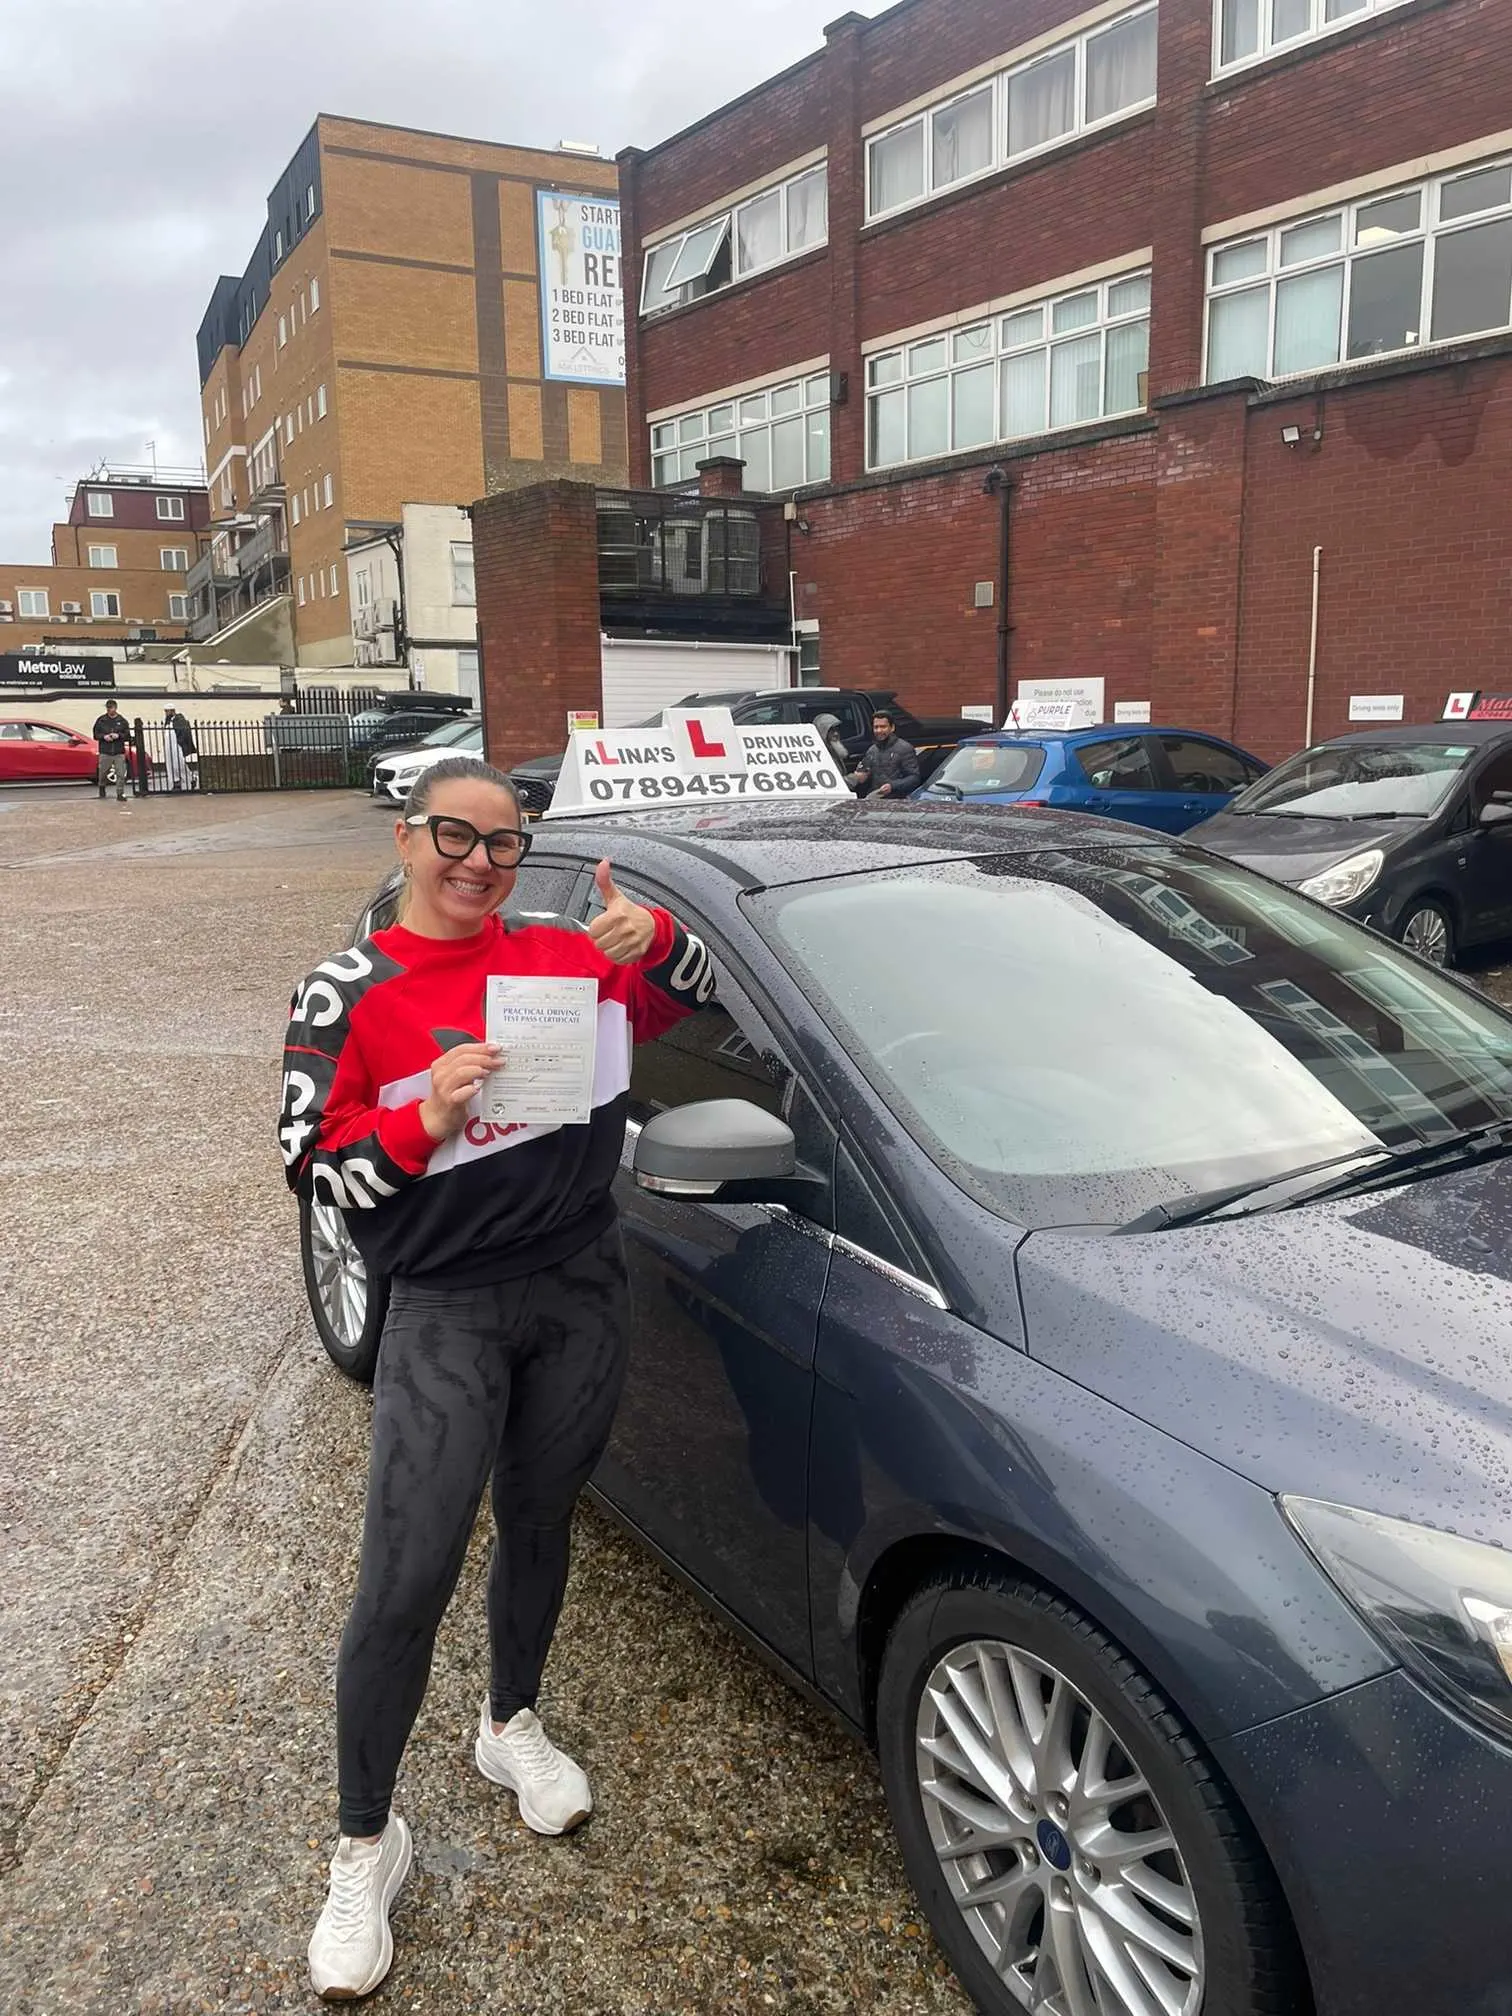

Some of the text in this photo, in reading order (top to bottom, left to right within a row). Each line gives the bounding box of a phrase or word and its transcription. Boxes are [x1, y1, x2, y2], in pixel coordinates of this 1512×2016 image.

[552, 289, 613, 308] 1 BED FLAT
[552, 308, 559, 322] 2
[563, 310, 585, 324] BED
[588, 312, 614, 327] FLAT
[553, 328, 560, 342] 3
[564, 329, 585, 344] BED
[589, 332, 615, 347] FLAT
[18, 660, 85, 674] MetroLaw
[1037, 705, 1072, 715] PURPLE
[1450, 698, 1464, 712] L
[685, 720, 726, 757] L
[742, 735, 815, 749] DRIVING
[746, 750, 821, 765] ACADEMY
[589, 769, 837, 800] 07894576840
[503, 1007, 581, 1017] PRACTICAL DRIVING
[504, 1015, 519, 1023] TEST
[539, 1016, 581, 1024] CERTIFICATE
